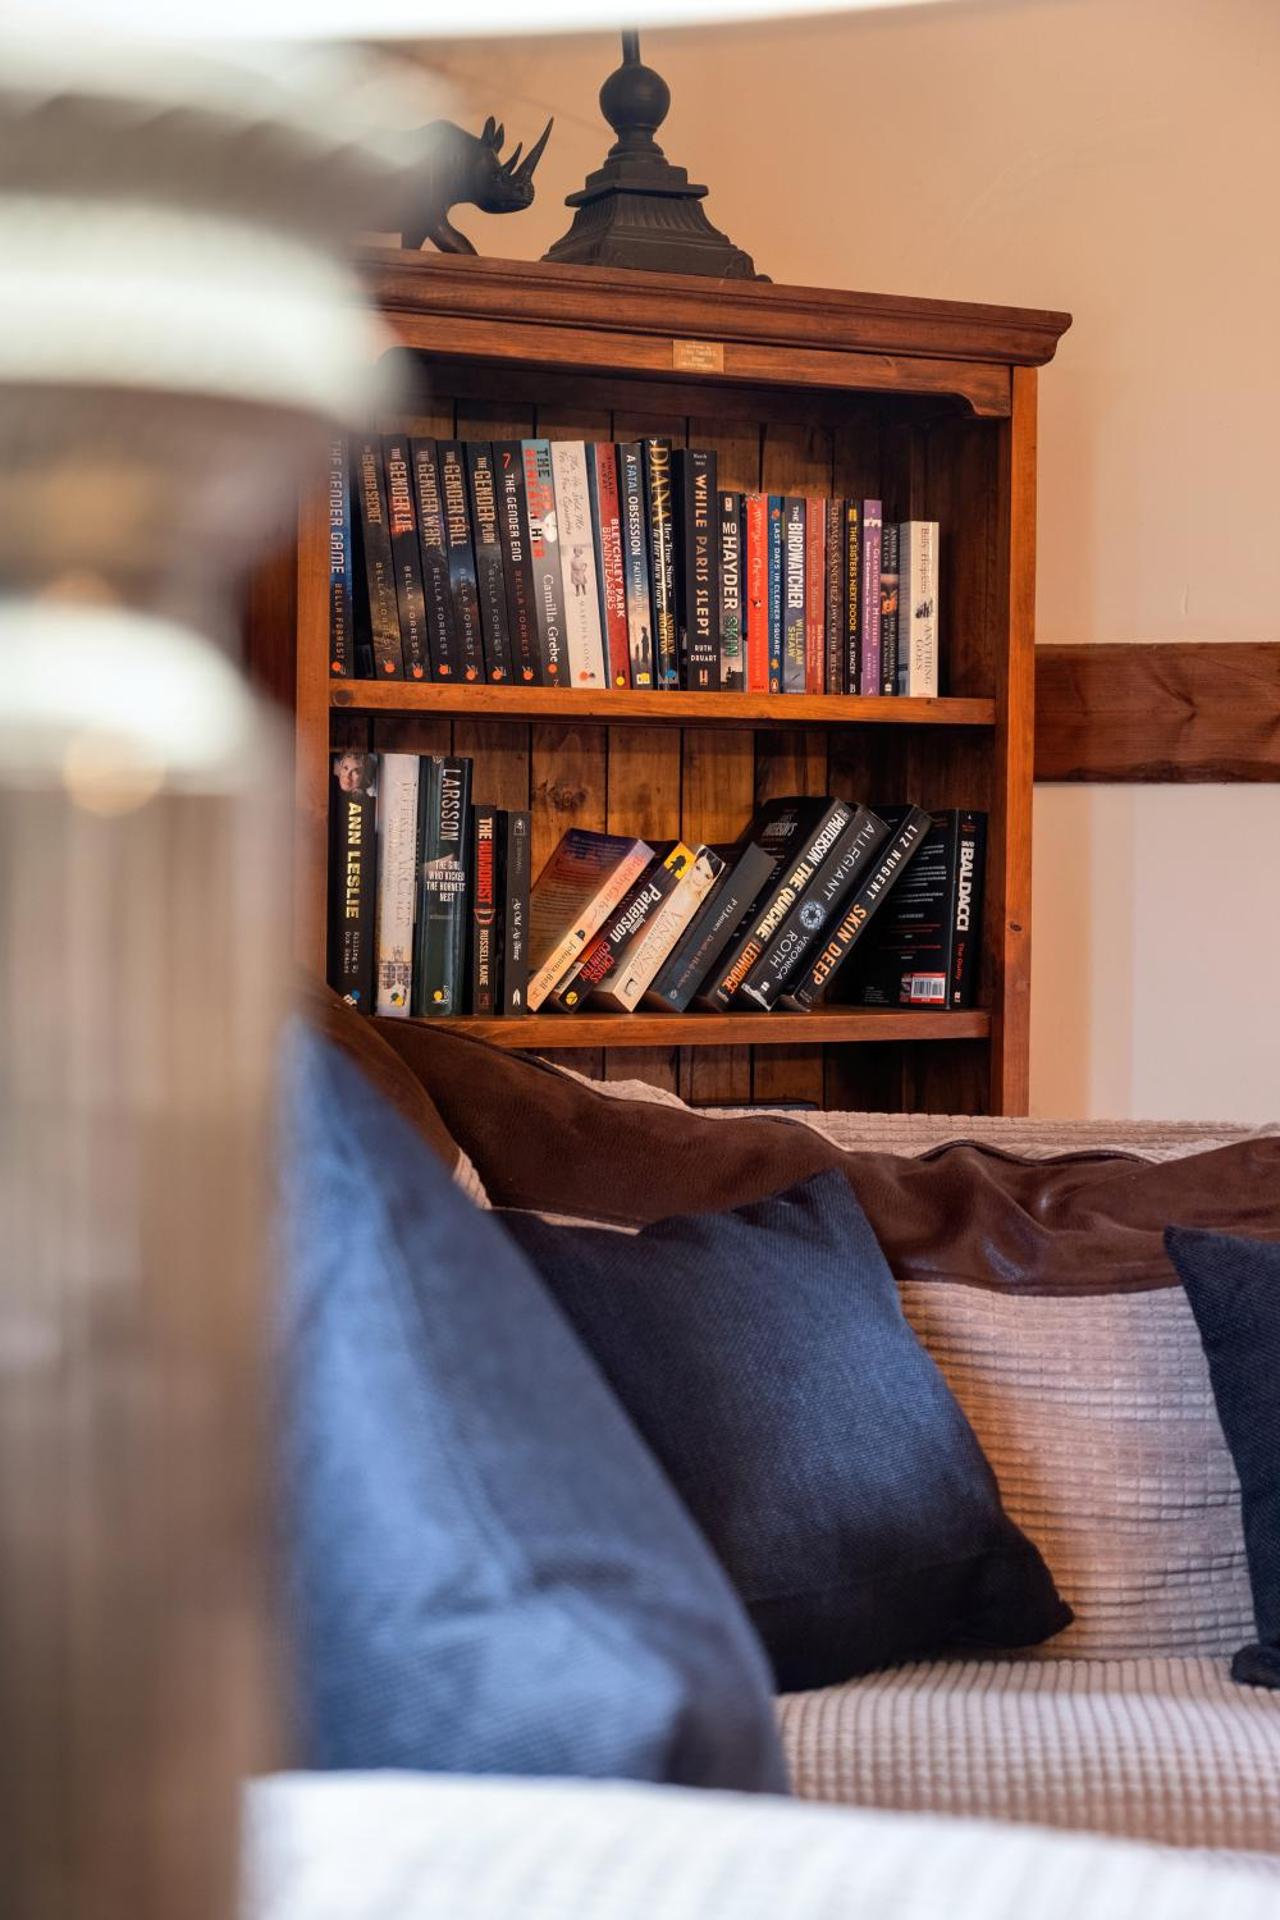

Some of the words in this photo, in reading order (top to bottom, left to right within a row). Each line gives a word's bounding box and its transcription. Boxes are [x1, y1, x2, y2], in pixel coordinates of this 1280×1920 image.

[330, 440, 341, 467] THE
[391, 448, 401, 459] THE
[419, 451, 430, 463] THE
[446, 452, 456, 464] THE
[477, 457, 487, 469] THE
[535, 446, 550, 477] THE
[625, 453, 636, 463] A
[362, 454, 378, 491] GENDER
[390, 461, 411, 511] GENDER
[418, 464, 440, 513] GENDER
[444, 465, 464, 514] GENDER
[505, 473, 515, 493] THE
[625, 463, 639, 495] FATAL
[647, 445, 672, 524] DIANA
[330, 471, 343, 526] GENDER
[365, 490, 382, 524] SECRET
[475, 471, 496, 522] GENDER
[695, 474, 707, 528] WHILE
[394, 513, 413, 533] LIE
[423, 514, 443, 547] WAR
[448, 516, 468, 547] FALL
[482, 523, 496, 544] PLAN
[507, 497, 519, 538] GENDER
[626, 495, 642, 556] OBSESSION
[662, 522, 672, 540] Her
[830, 503, 838, 551] THOMAS
[331, 533, 344, 573] GAME
[512, 541, 522, 561] END
[609, 517, 624, 584] BLETCHLEY
[663, 541, 673, 564] True
[695, 536, 708, 582] PARIS
[889, 527, 897, 568] ANDREW
[375, 562, 385, 597] BELLA
[600, 525, 617, 610] BRAINTEASERS
[631, 560, 642, 584] FAITH
[653, 559, 662, 579] Own
[664, 564, 674, 590] Story
[723, 536, 738, 609] HAYDER
[773, 572, 780, 581] IN
[788, 523, 804, 609] BIRDWATCHER
[829, 550, 838, 603] SANCHEZ
[335, 583, 343, 613] BELLA
[460, 569, 469, 602] BELLA
[488, 569, 498, 604] BELLA
[541, 572, 558, 622] Camilla
[614, 587, 626, 618] PARK
[654, 580, 664, 609] Words
[849, 579, 857, 604] NEXT
[404, 566, 413, 600] BELLA
[409, 605, 420, 656] FORREST
[433, 567, 443, 602] BELLA
[438, 607, 448, 656] FORREST
[515, 570, 525, 604] BELLA
[520, 609, 530, 657] FORREST
[696, 589, 710, 637] SLEPT
[829, 603, 837, 621] DAY
[849, 604, 857, 631] DOOR
[336, 617, 344, 659] FORREST
[463, 607, 475, 656] FORREST
[492, 608, 502, 657] FORREST
[545, 625, 562, 663] Grebe
[657, 612, 668, 656] MORTON
[664, 610, 675, 654] ANDREW
[694, 644, 713, 653] RUTH
[724, 616, 738, 658] SKIN
[788, 625, 796, 658] SHAW
[795, 617, 804, 665] WILLIAM
[690, 654, 717, 662] DRUART
[914, 638, 922, 671] GOES
[923, 623, 932, 685] ANYTHING
[346, 801, 362, 845] ANN
[440, 769, 461, 841] LARSSON
[478, 818, 493, 840] THE
[802, 811, 848, 867] PATTERSON
[897, 823, 919, 849] LIZ
[429, 871, 444, 880] WHO
[445, 872, 465, 881] KICKED
[435, 860, 447, 870] THE
[478, 841, 493, 903] HUMORIST
[785, 859, 815, 893] THE
[816, 819, 879, 901] ALLEGIANT
[863, 847, 903, 900] NUGENT
[345, 850, 361, 919] LESLIE
[396, 854, 411, 927] ARCHER
[426, 881, 438, 891] THE
[440, 892, 455, 902] NEST
[956, 846, 974, 931] BALDACCI
[513, 910, 521, 926] Old
[605, 882, 663, 946] Patterson
[627, 913, 647, 935] James
[710, 909, 730, 933] James
[751, 884, 799, 942] QUICKIE
[834, 902, 869, 944] SKIN
[480, 929, 489, 964] RUSSELL
[549, 940, 578, 976] Johanna
[574, 939, 613, 982] COUNTRY
[766, 929, 800, 969] ROTH
[772, 932, 811, 982] VERONICA
[807, 940, 844, 986] DEEP
[956, 942, 964, 956] The
[480, 965, 489, 986] KANE
[538, 972, 555, 990] Bell
[586, 952, 617, 985] CROSS
[718, 940, 763, 994] LEDWIDGE
